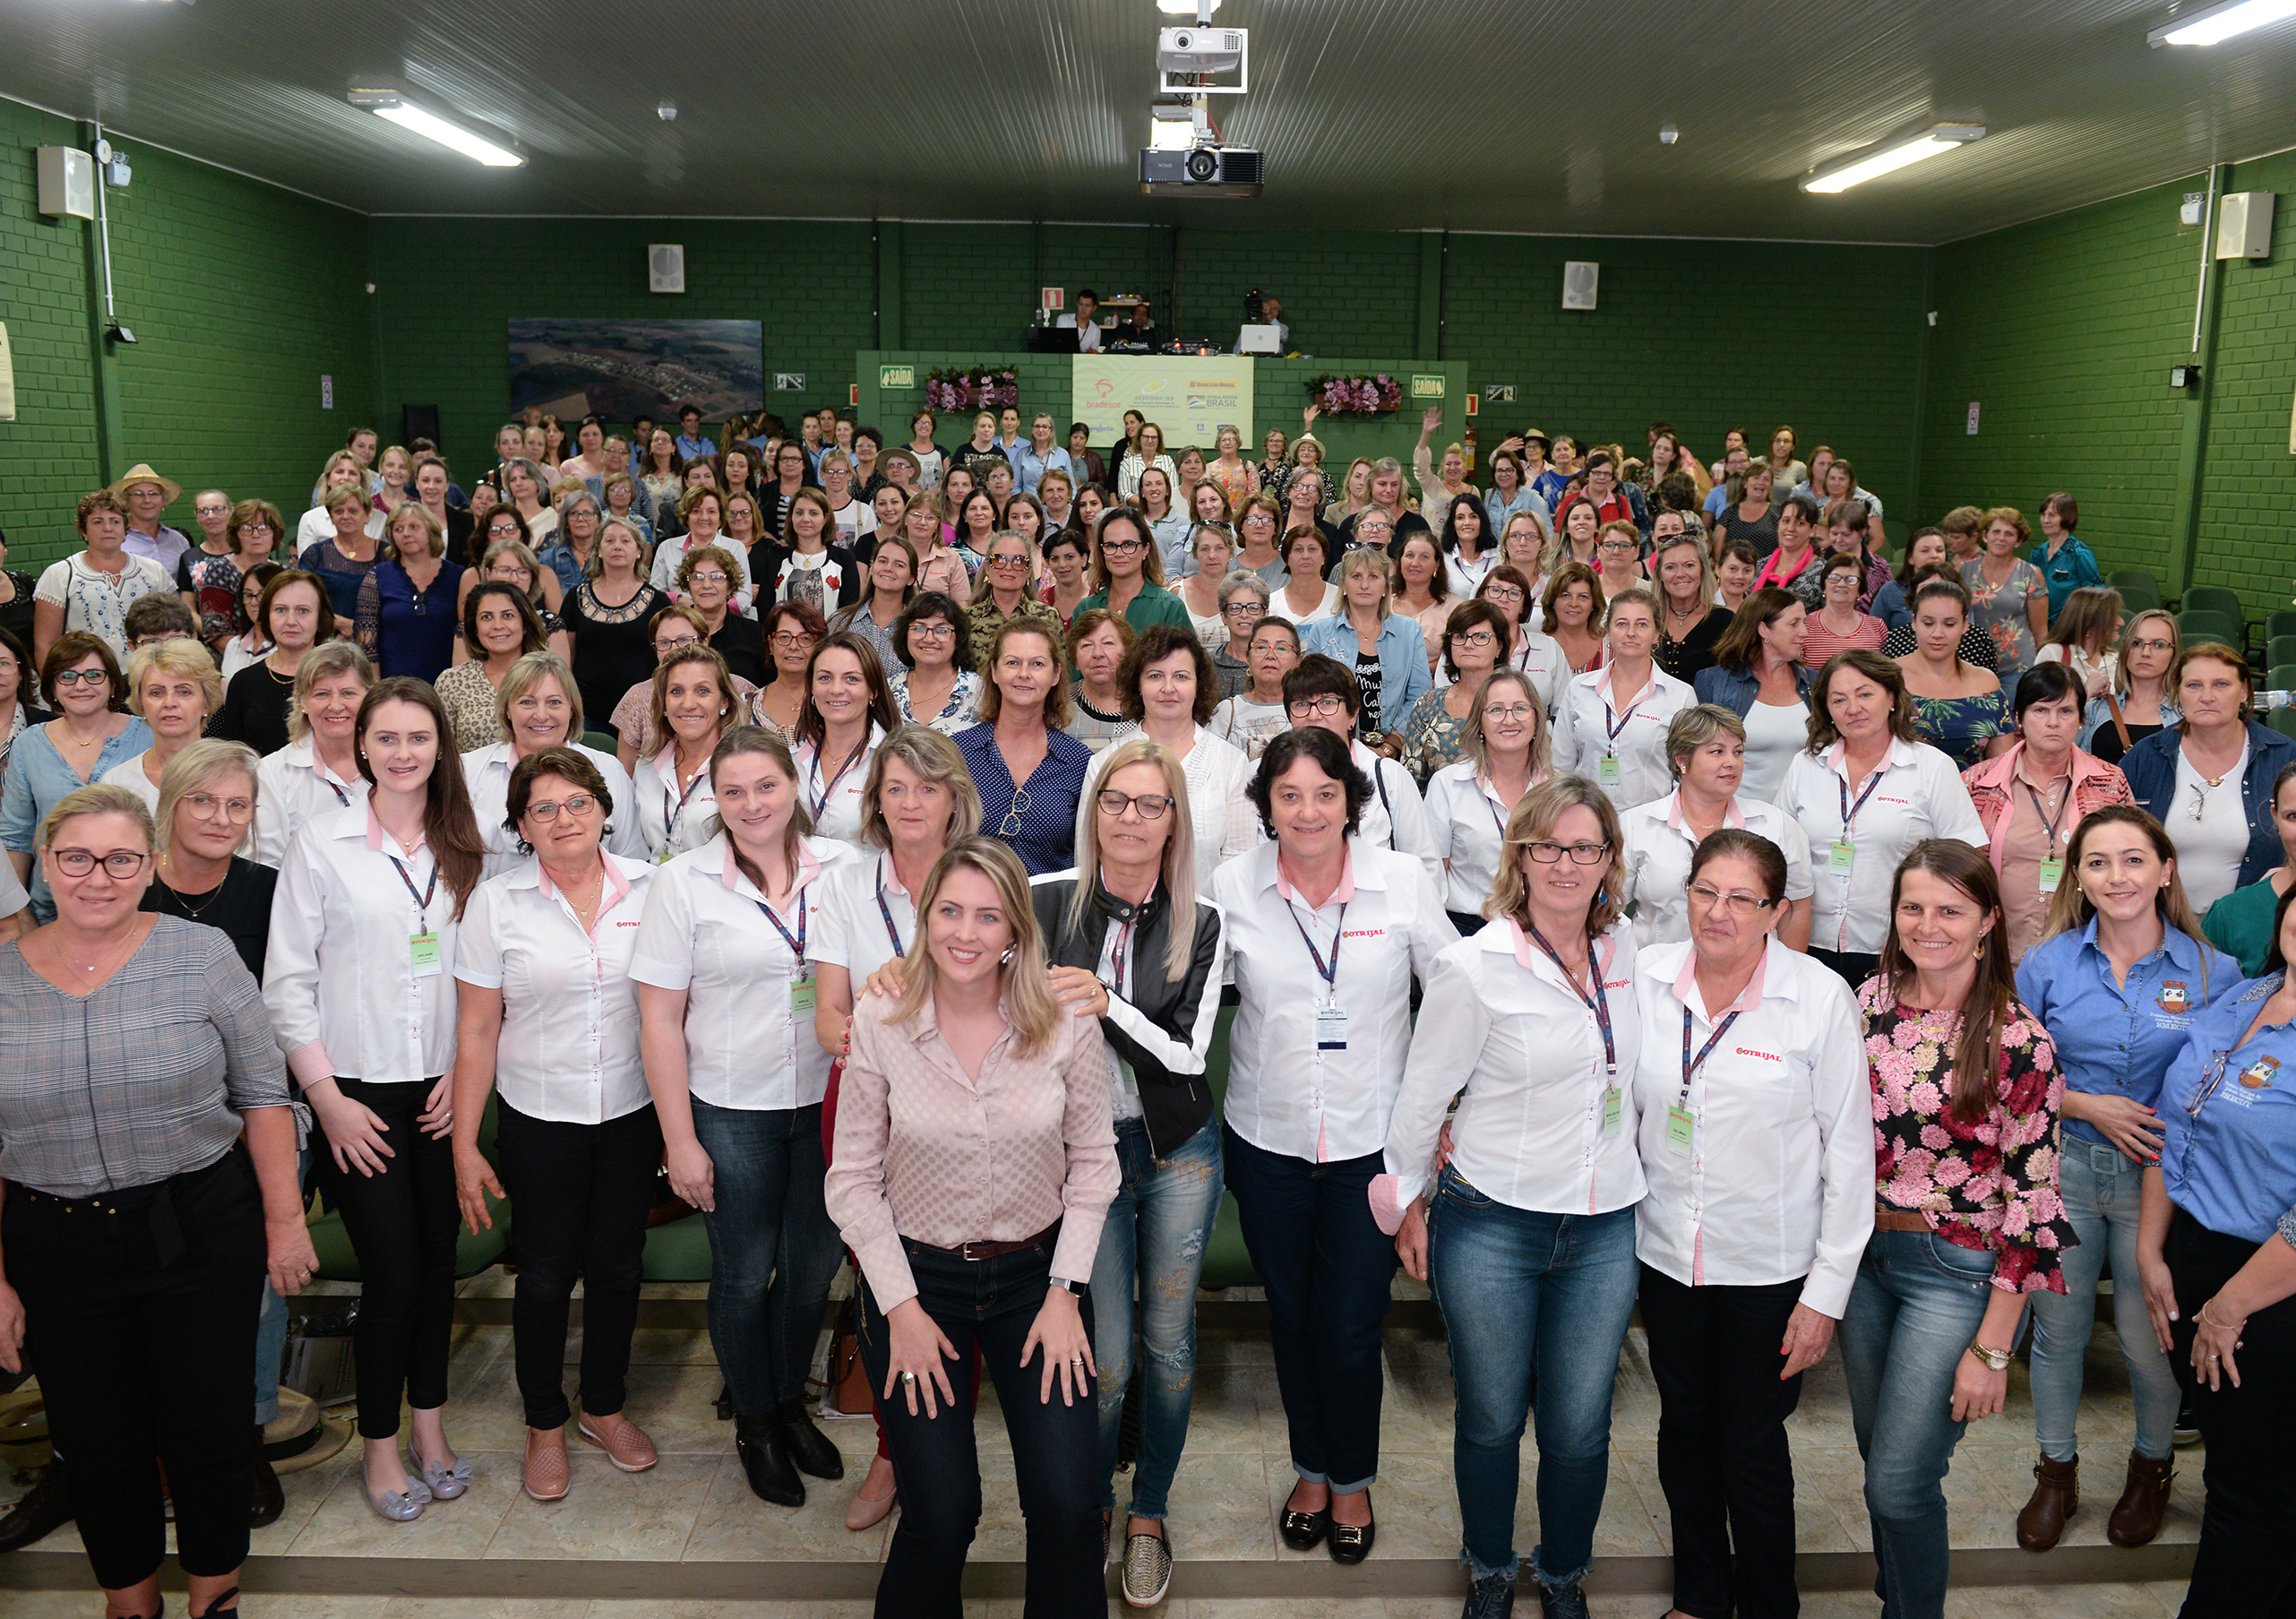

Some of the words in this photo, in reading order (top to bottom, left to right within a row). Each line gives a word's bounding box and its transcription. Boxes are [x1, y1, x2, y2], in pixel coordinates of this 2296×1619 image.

[890, 367, 912, 384] SAÍDA
[1415, 377, 1437, 394] SAÍDA
[1087, 400, 1121, 409] bradesco
[1088, 425, 1114, 433] yngenta
[1343, 930, 1385, 938] COTRIJAL
[1604, 978, 1630, 989] COTRIJAL
[1736, 1047, 1782, 1062] COTRIJAL
